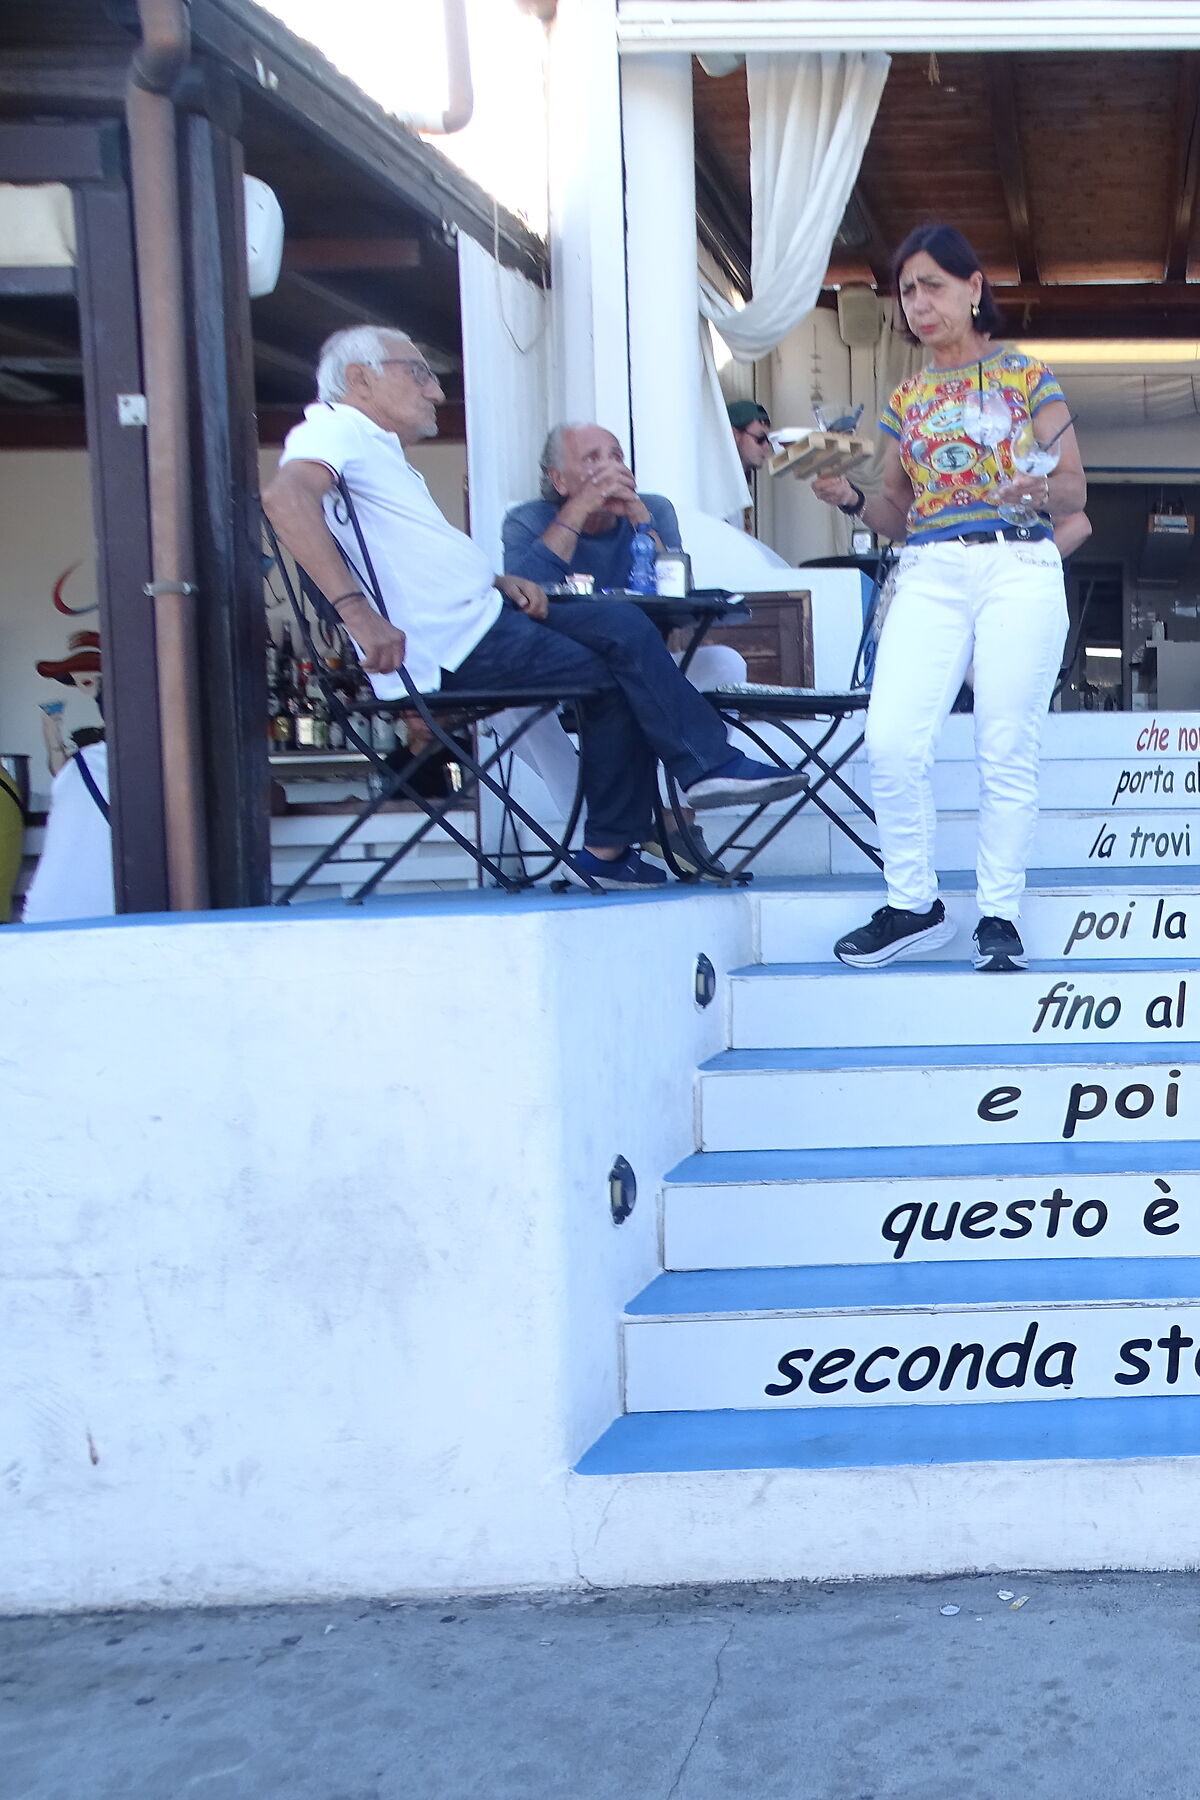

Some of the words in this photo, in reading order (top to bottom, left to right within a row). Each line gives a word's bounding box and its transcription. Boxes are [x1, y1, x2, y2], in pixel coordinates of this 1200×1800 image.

[1136, 718, 1170, 752] che
[1111, 764, 1175, 806] porta
[1088, 822, 1117, 859] la
[1129, 823, 1191, 859] trovi
[1063, 900, 1136, 956] poi
[1152, 898, 1187, 940] la
[1032, 981, 1122, 1034] fino
[1145, 980, 1187, 1029] al
[977, 1085, 1022, 1122] e
[1061, 1069, 1182, 1139] poi
[881, 1188, 1109, 1260] questo
[1143, 1178, 1180, 1236] è
[764, 1321, 1078, 1397] seconda
